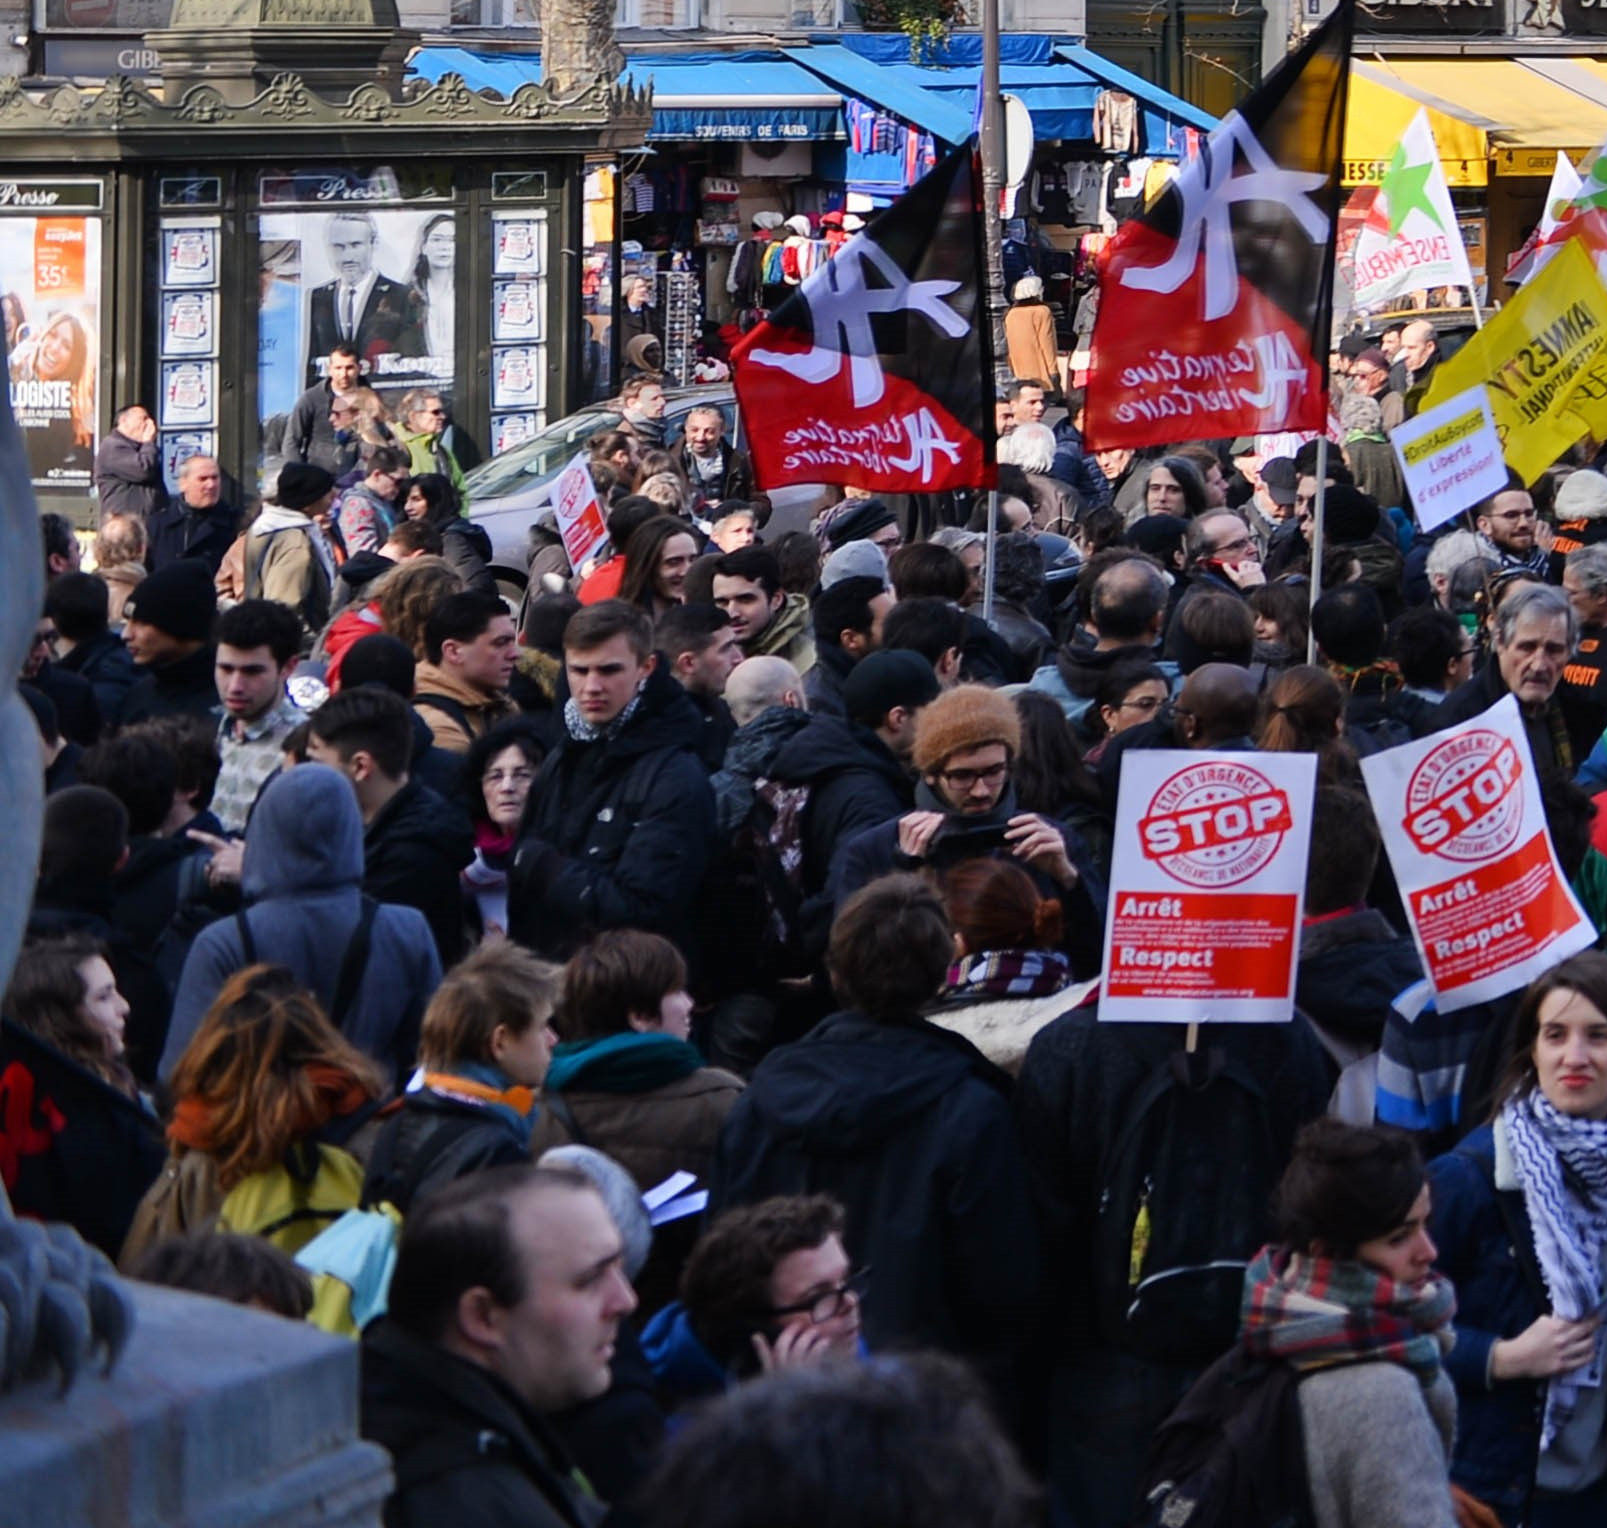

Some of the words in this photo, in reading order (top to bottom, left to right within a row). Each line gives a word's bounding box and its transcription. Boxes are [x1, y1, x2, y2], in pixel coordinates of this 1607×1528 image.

[758, 125, 772, 136] DE
[1411, 746, 1515, 845] STOP
[1145, 796, 1284, 854] STOP
[1121, 897, 1182, 918] Arrêt
[1419, 878, 1478, 915] Arrêt
[1434, 910, 1526, 960] Respect
[1119, 947, 1214, 970] Respect
